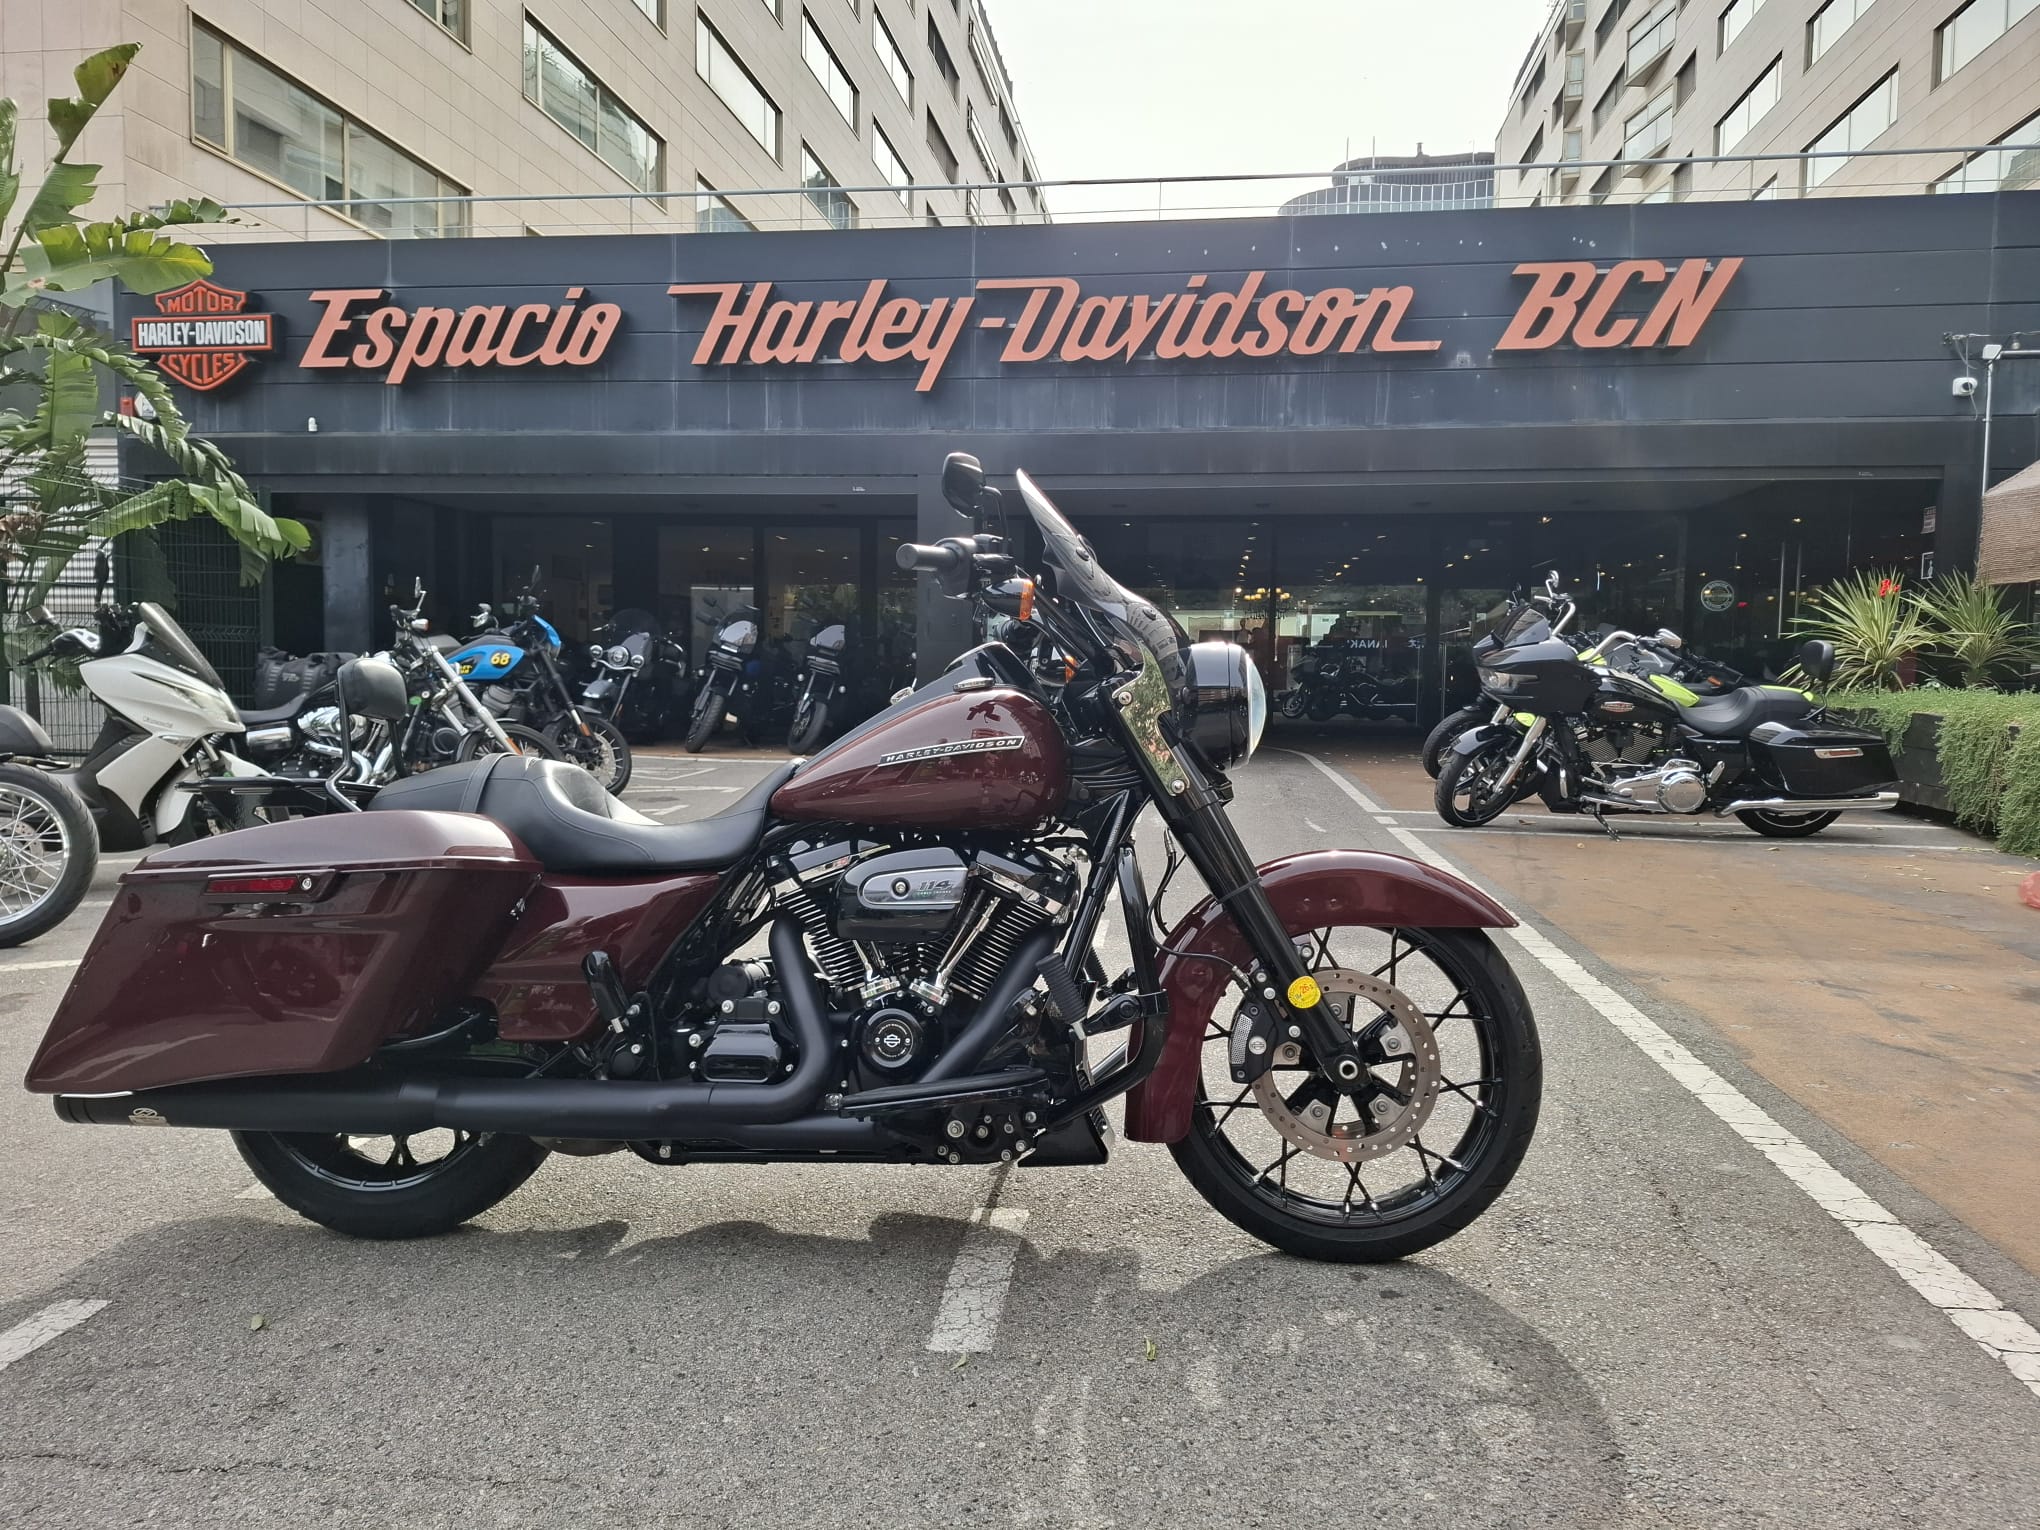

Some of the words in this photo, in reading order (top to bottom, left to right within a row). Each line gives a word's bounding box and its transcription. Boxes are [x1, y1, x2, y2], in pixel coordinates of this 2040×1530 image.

[168, 286, 235, 313] MOTOR
[138, 320, 265, 346] HARLEY-DAVIDSON
[299, 287, 621, 384] Espacio
[666, 271, 1442, 391] Harley-Davidson
[1495, 257, 1744, 350] BCN
[167, 353, 236, 385] CYCLES
[490, 652, 511, 666] 68
[886, 739, 1017, 762] HARLEY-DAVIDSON
[919, 880, 955, 892] 114
